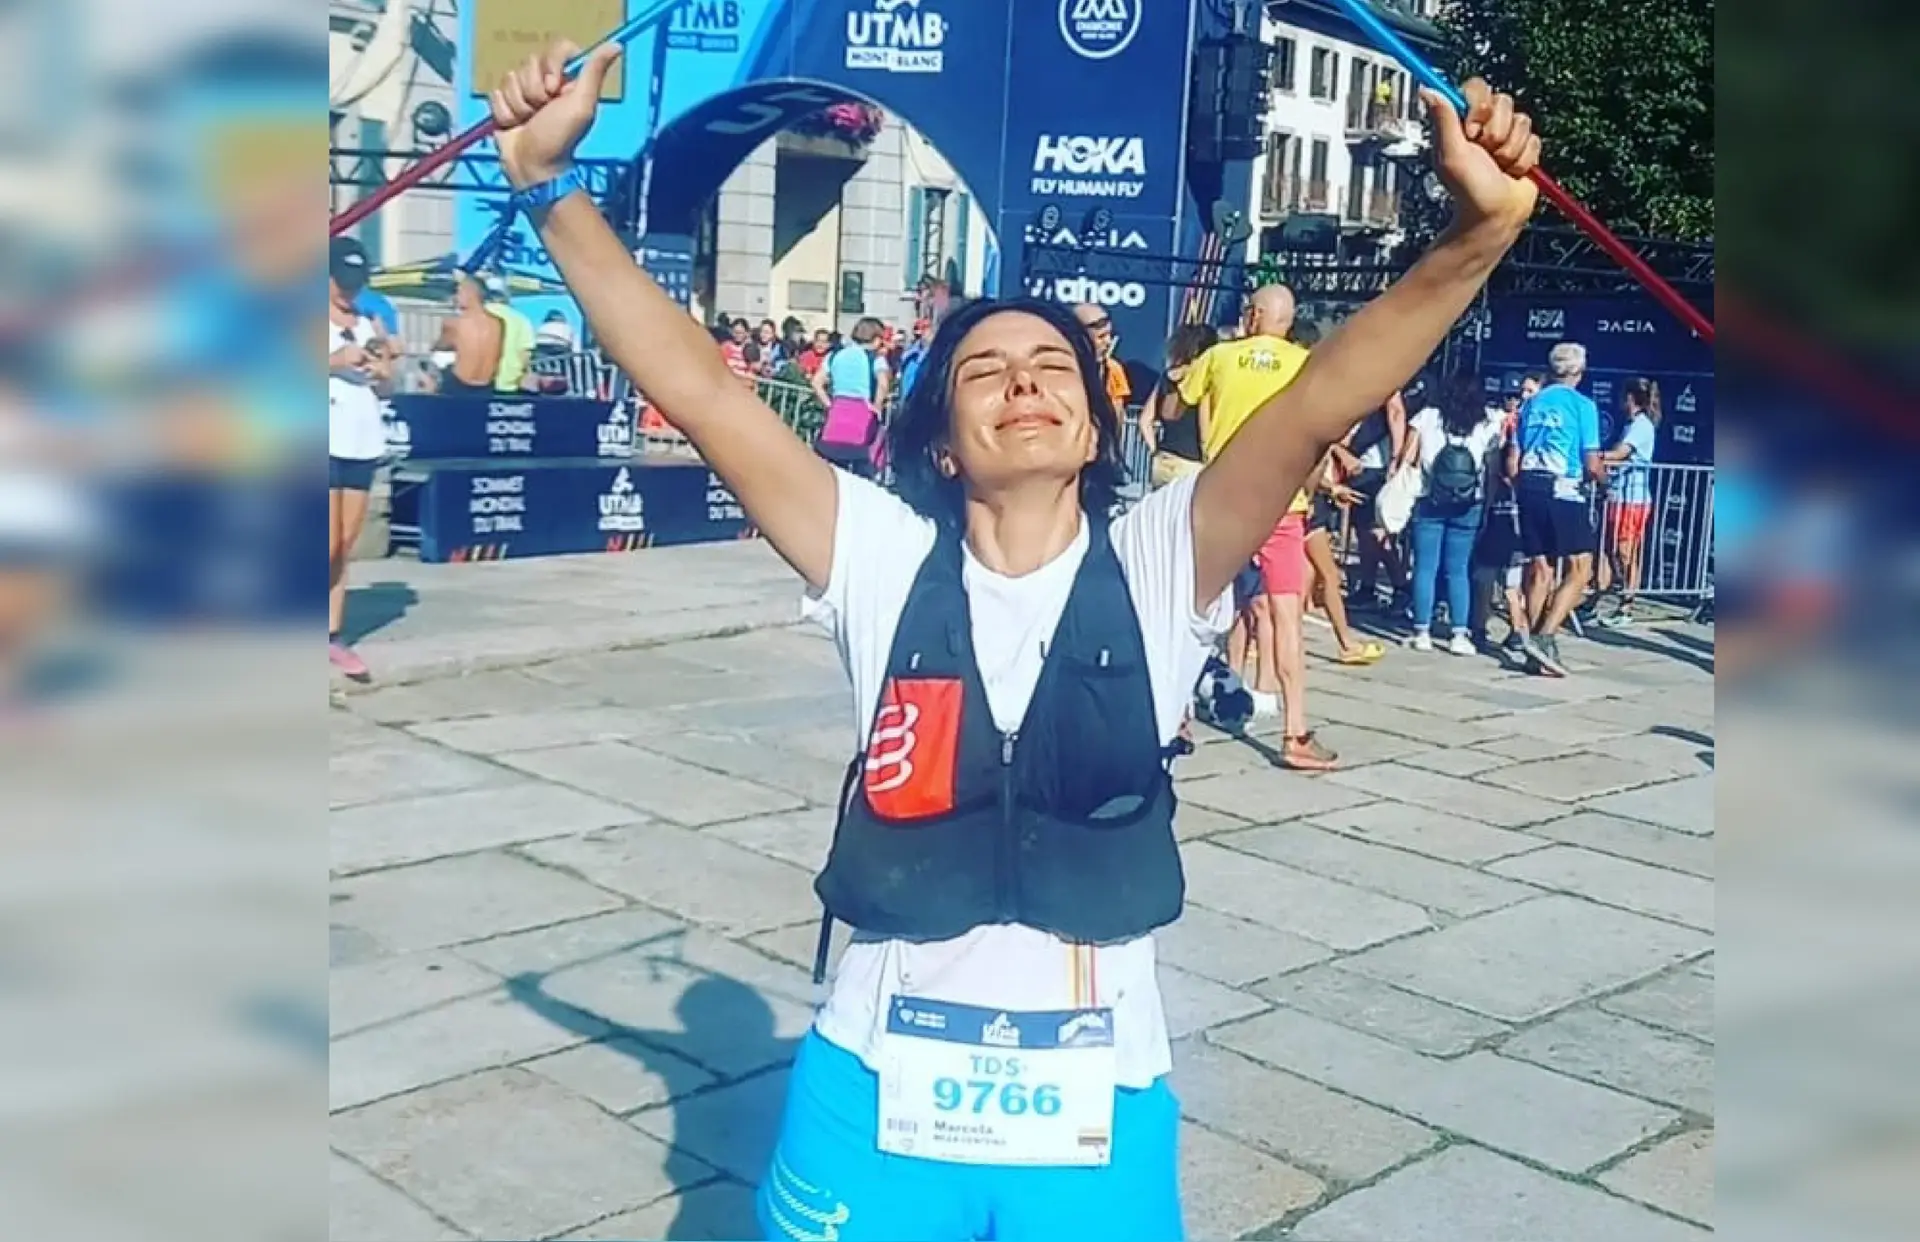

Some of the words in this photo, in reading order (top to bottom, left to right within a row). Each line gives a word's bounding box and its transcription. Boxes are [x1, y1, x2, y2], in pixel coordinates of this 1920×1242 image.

[668, 0, 739, 28] TMB
[847, 10, 943, 46] UTMB
[1032, 134, 1146, 175] HOKA
[1031, 178, 1057, 194] FLY
[1058, 179, 1116, 197] HUMAN
[1117, 181, 1144, 197] FLY
[1598, 319, 1655, 333] DACIA
[969, 1055, 1021, 1077] TDS
[933, 1077, 1062, 1116] 9766
